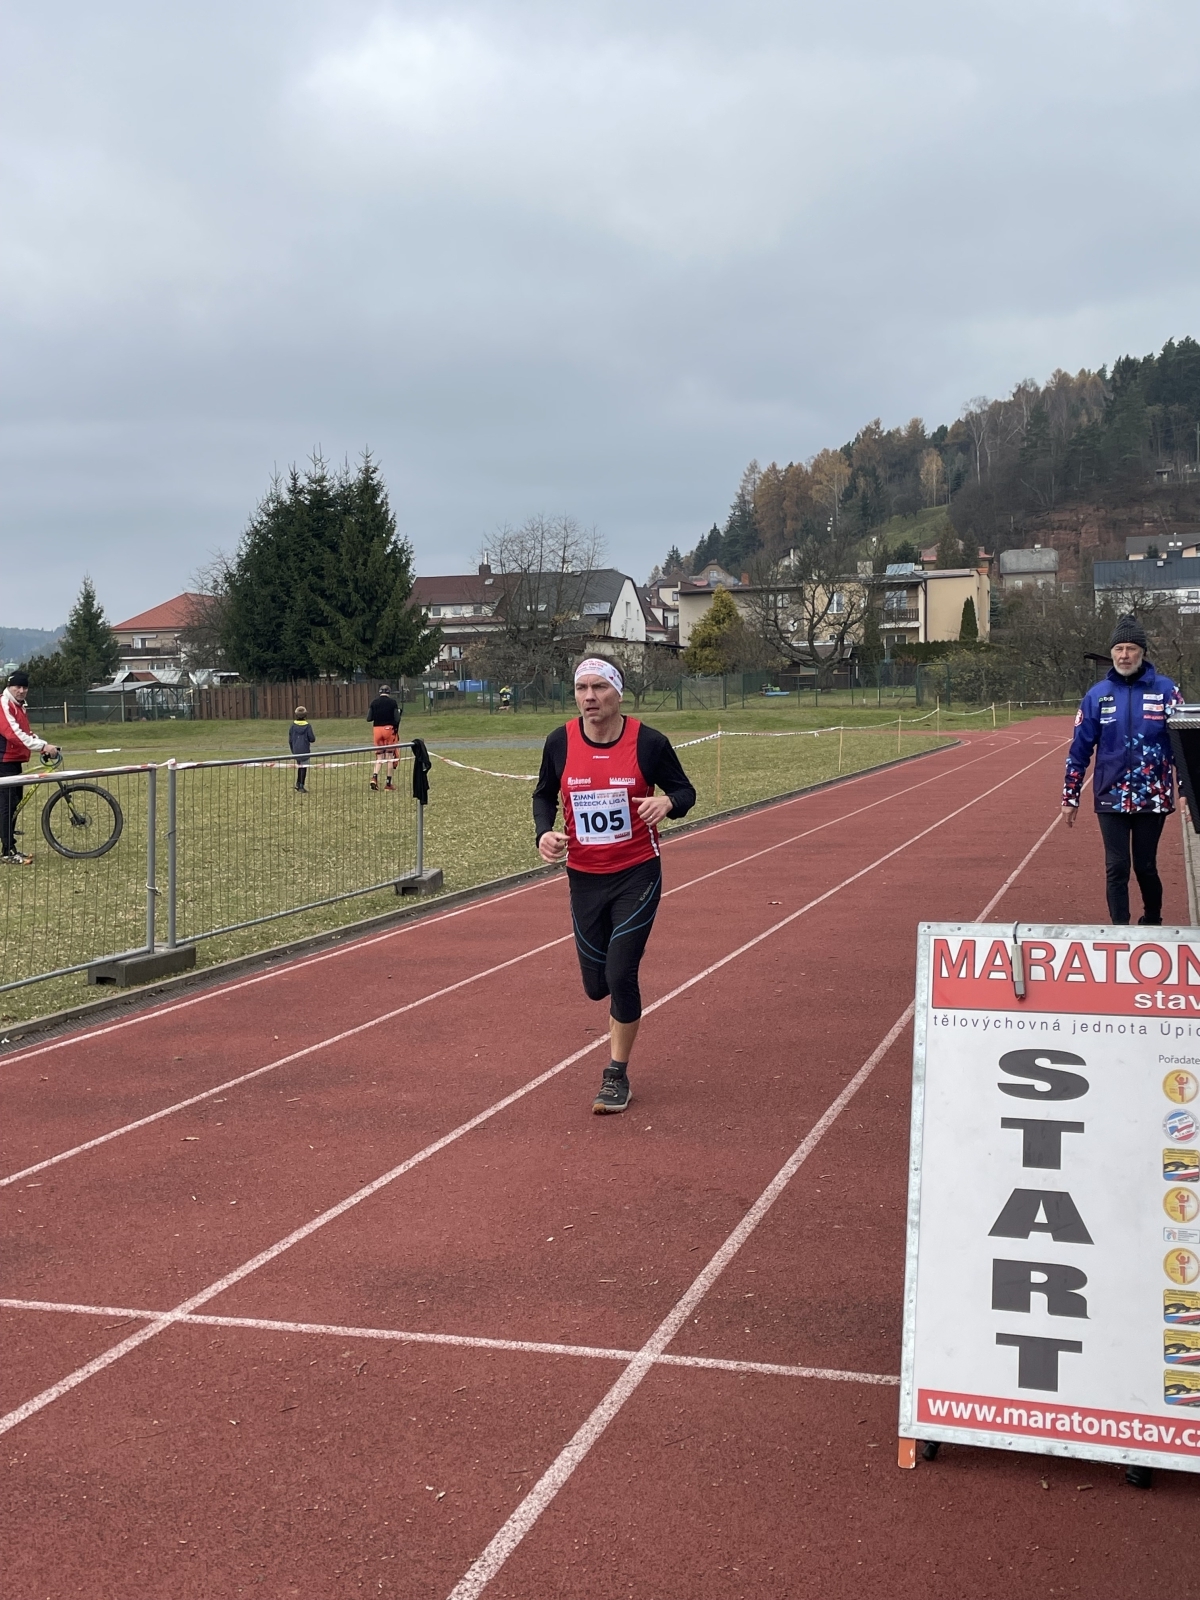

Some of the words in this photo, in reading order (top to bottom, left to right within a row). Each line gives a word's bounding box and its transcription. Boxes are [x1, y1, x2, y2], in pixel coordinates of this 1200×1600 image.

[580, 809, 624, 833] 105
[933, 938, 1200, 985] MARATON
[1134, 990, 1200, 1010] stav
[933, 1014, 1061, 1032] tělovýchovná
[1072, 1020, 1147, 1035] jednota
[987, 1049, 1095, 1392] START
[928, 1398, 1200, 1448] www.maratonstav.c
